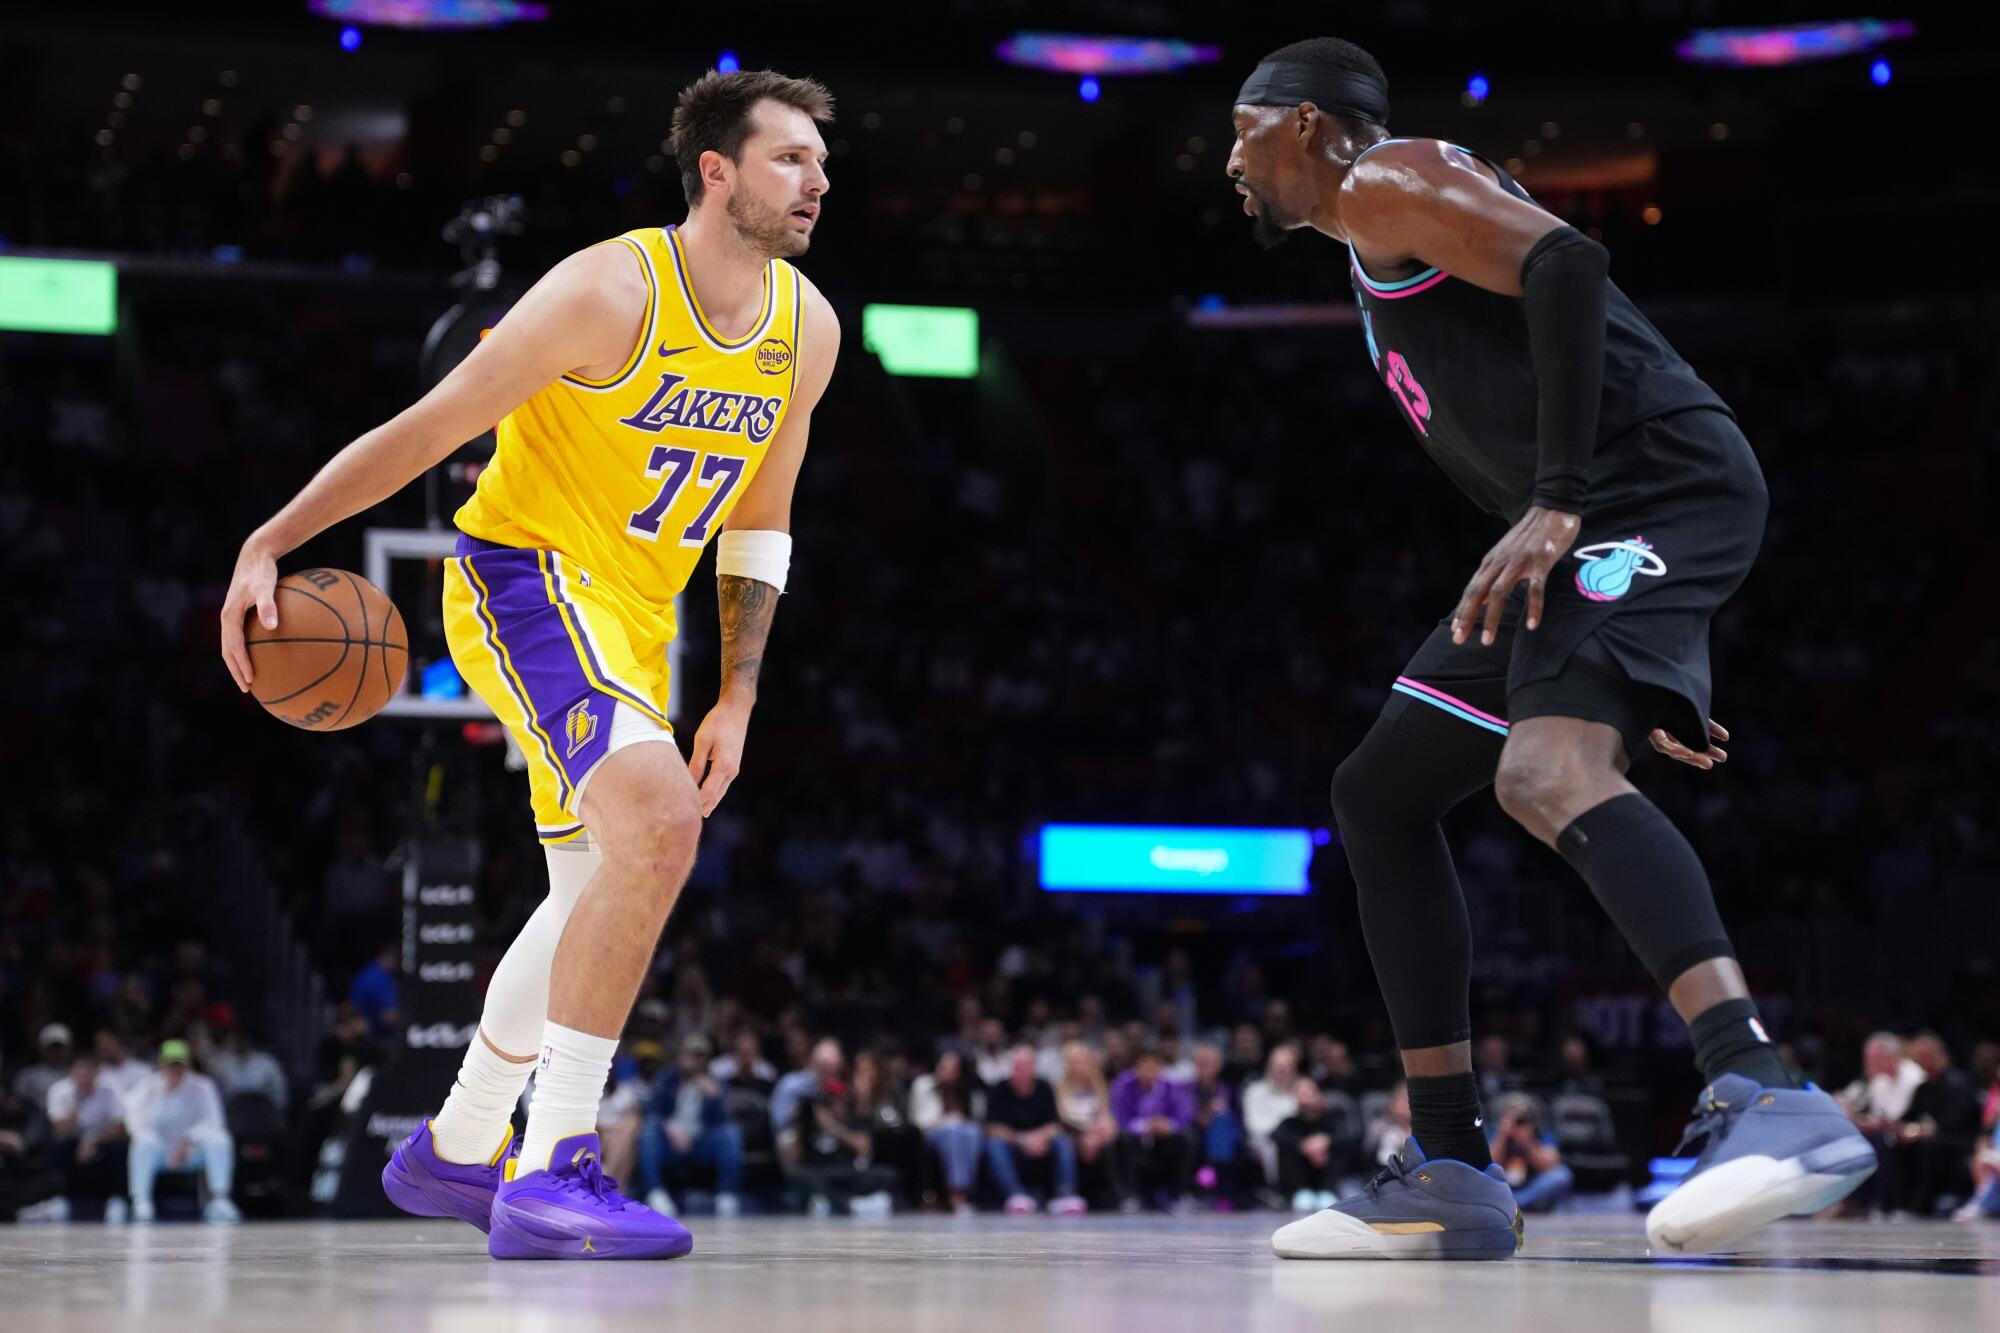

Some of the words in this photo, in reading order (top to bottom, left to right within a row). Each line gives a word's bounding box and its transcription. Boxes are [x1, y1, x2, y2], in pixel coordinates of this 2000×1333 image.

[758, 348, 789, 365] bibigo
[617, 372, 782, 443] LAKERS
[626, 445, 748, 548] 77
